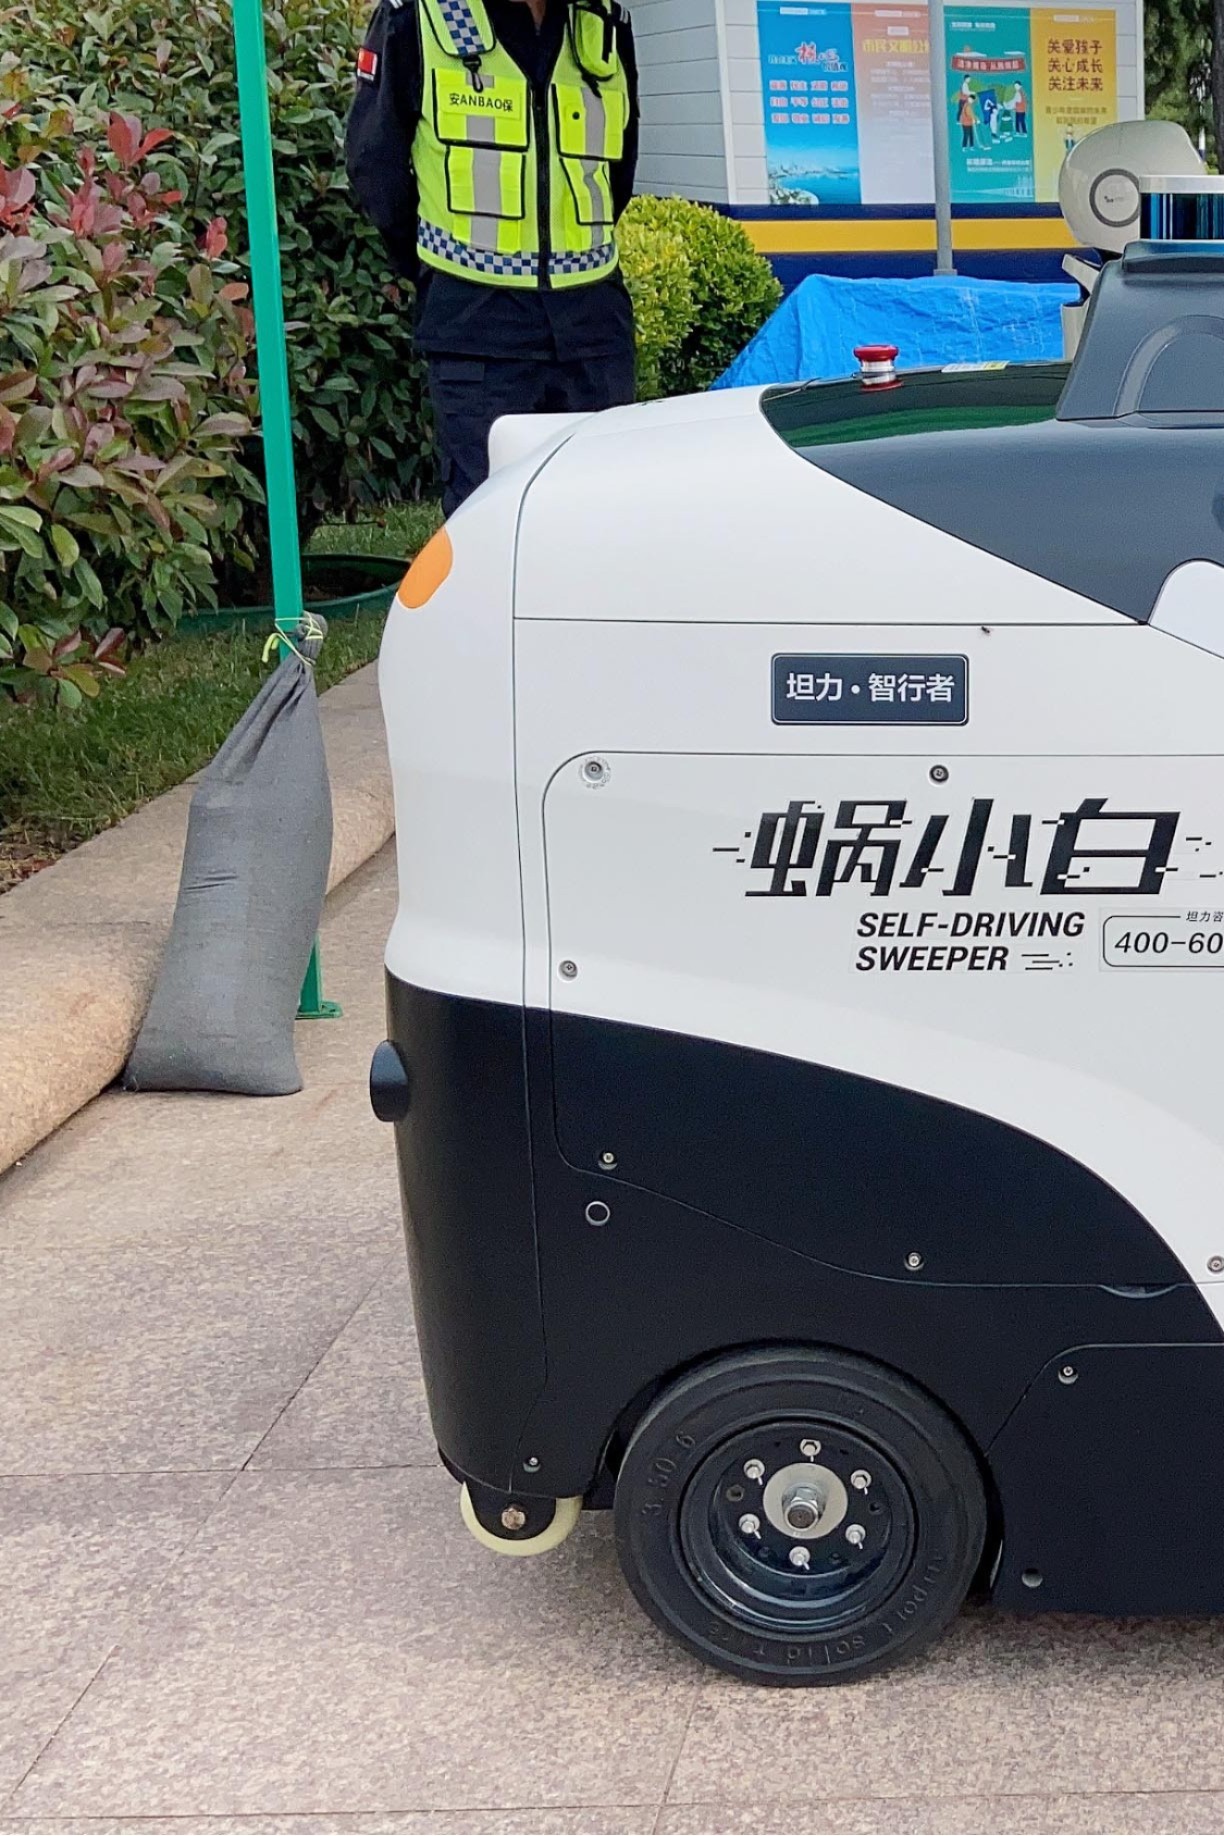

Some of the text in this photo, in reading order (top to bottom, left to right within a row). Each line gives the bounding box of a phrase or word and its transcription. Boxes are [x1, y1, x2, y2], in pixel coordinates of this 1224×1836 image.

[1047, 38, 1103, 54] 关爱孩子
[1047, 57, 1104, 73] 关心成长
[1048, 76, 1104, 92] 关注未来
[785, 672, 956, 703] 坦力·智行者
[744, 797, 1182, 897] 蜗小白
[856, 911, 1086, 938] SELF-DRIVING
[855, 945, 1010, 972] SWEEPER
